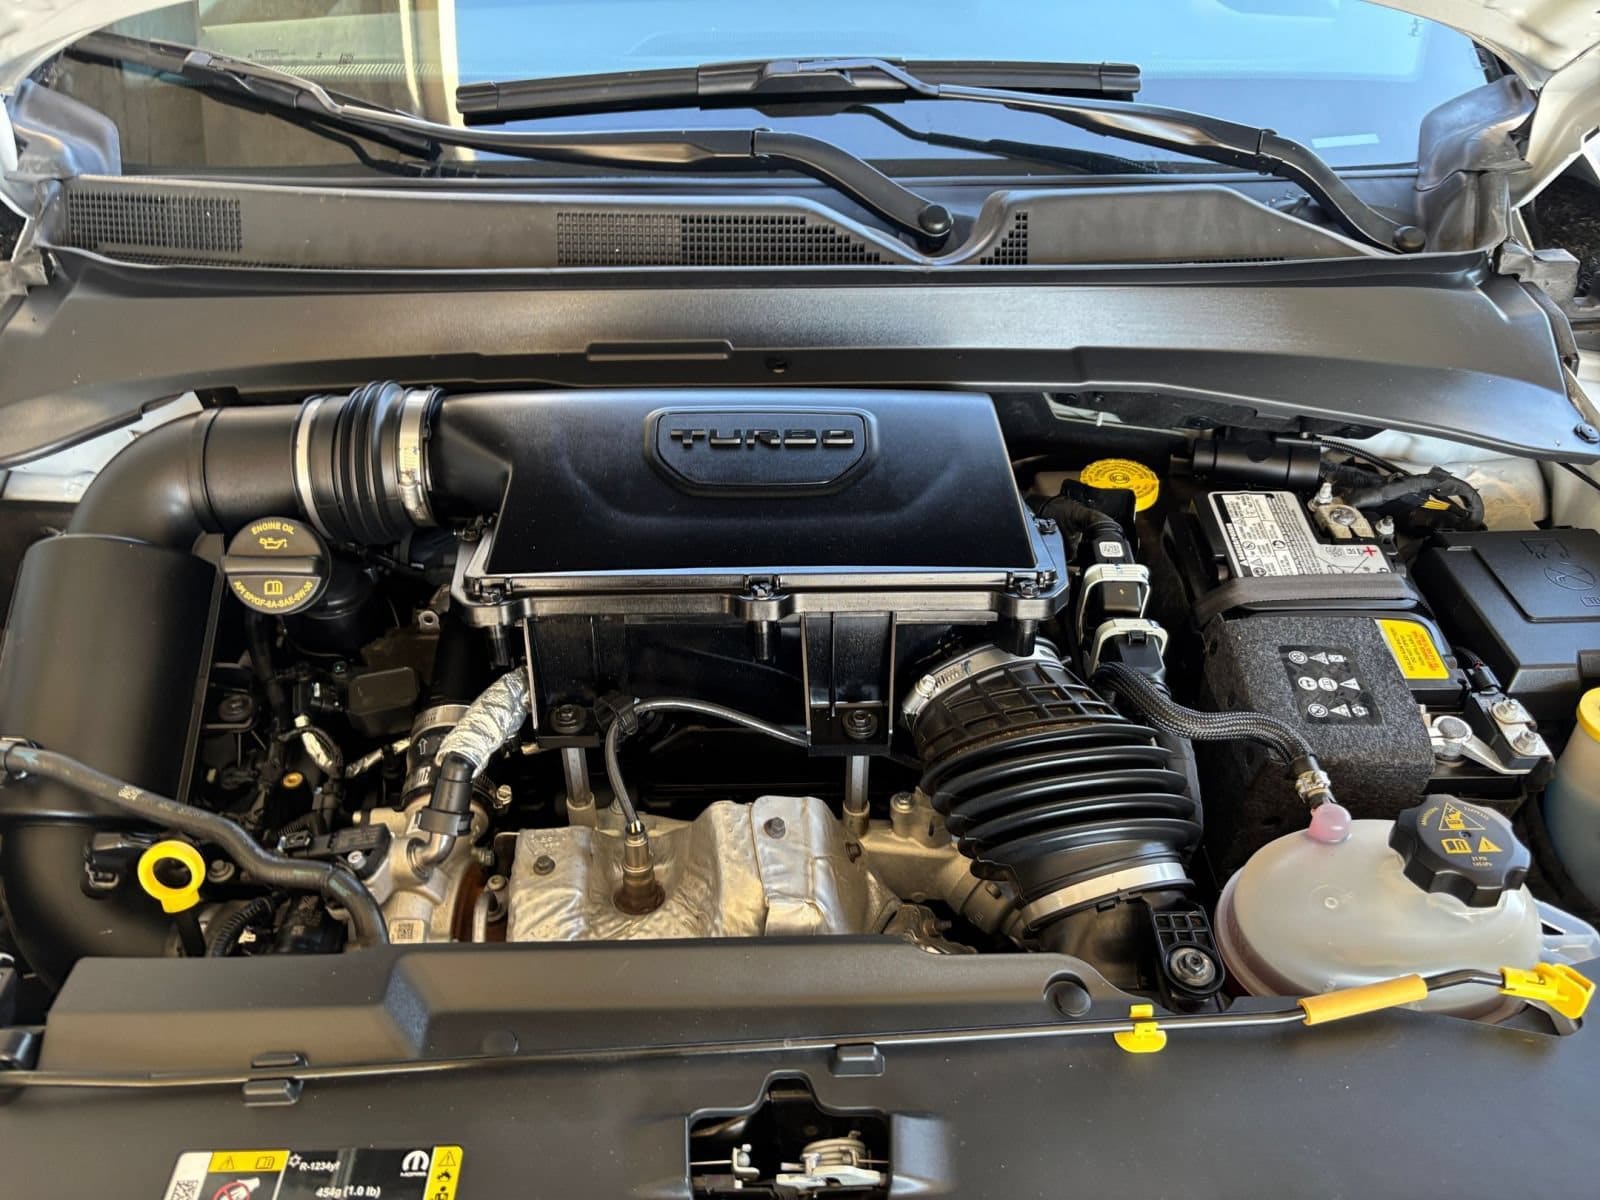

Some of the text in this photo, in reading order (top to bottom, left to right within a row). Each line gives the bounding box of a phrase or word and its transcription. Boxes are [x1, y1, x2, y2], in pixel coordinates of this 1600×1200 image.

[670, 428, 855, 450] TURBO
[251, 520, 296, 535] ENGINE OIL
[299, 1161, 340, 1172] R-1234yf
[315, 1185, 381, 1199] 454g (1.0 lb)
